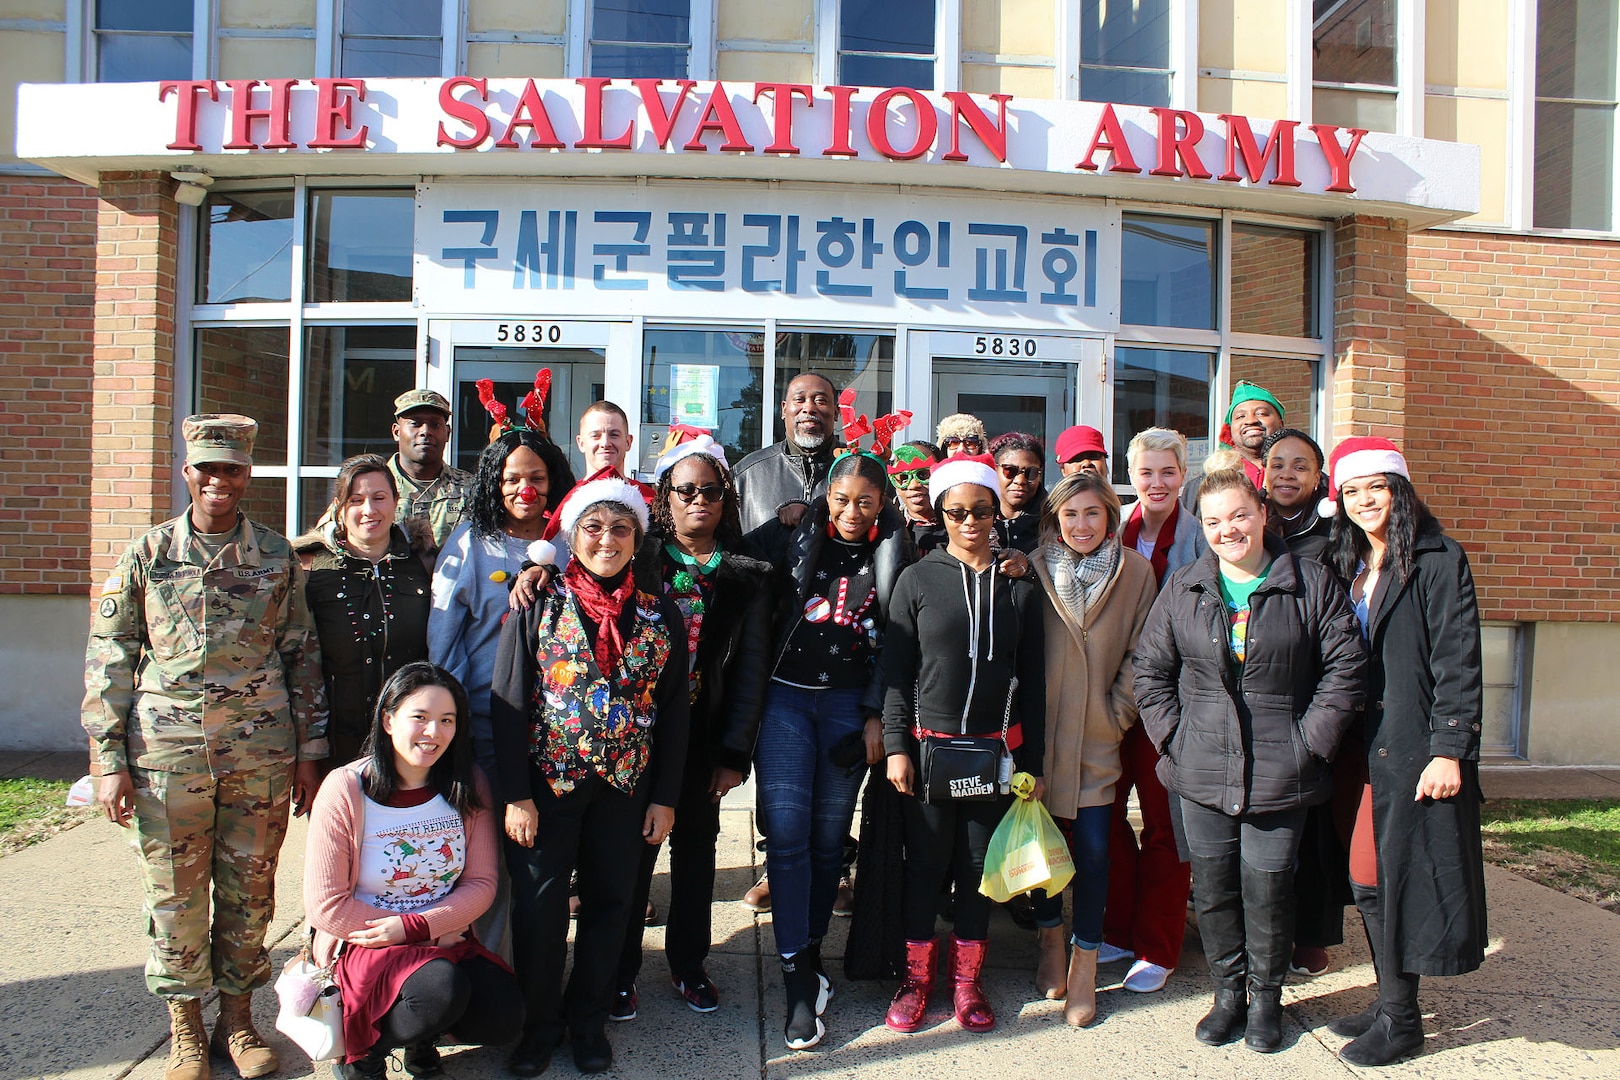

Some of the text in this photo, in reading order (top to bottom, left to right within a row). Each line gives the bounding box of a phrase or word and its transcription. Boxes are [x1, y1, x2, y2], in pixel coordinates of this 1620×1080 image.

[158, 75, 1370, 193] THE SALVATION ARMY
[497, 324, 561, 343] 5830
[975, 337, 1037, 357] 5830
[949, 775, 982, 790] STEVE
[951, 782, 994, 798] MADDEN
